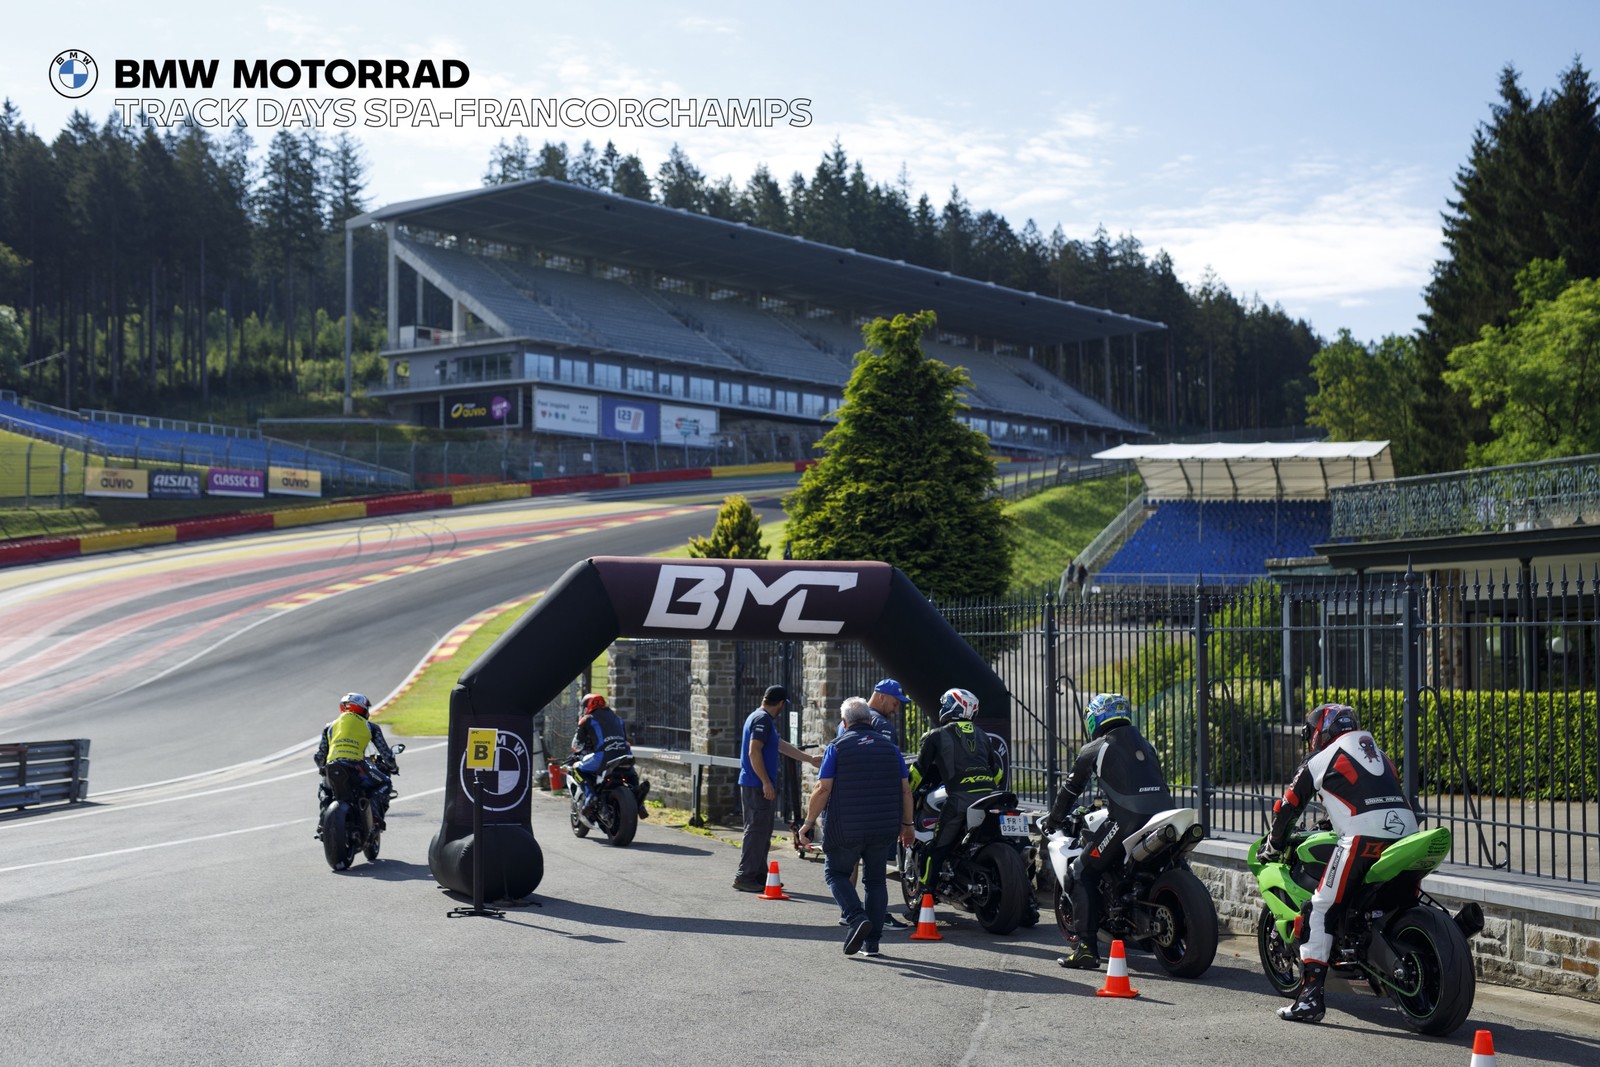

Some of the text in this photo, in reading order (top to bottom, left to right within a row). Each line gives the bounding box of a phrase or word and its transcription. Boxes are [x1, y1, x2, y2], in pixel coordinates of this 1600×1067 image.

[617, 409, 633, 421] 123
[153, 474, 193, 488] AISIN
[213, 473, 259, 488] CLASSIC 21
[643, 564, 859, 635] BMC
[474, 745, 489, 760] B
[960, 775, 994, 784] IXON
